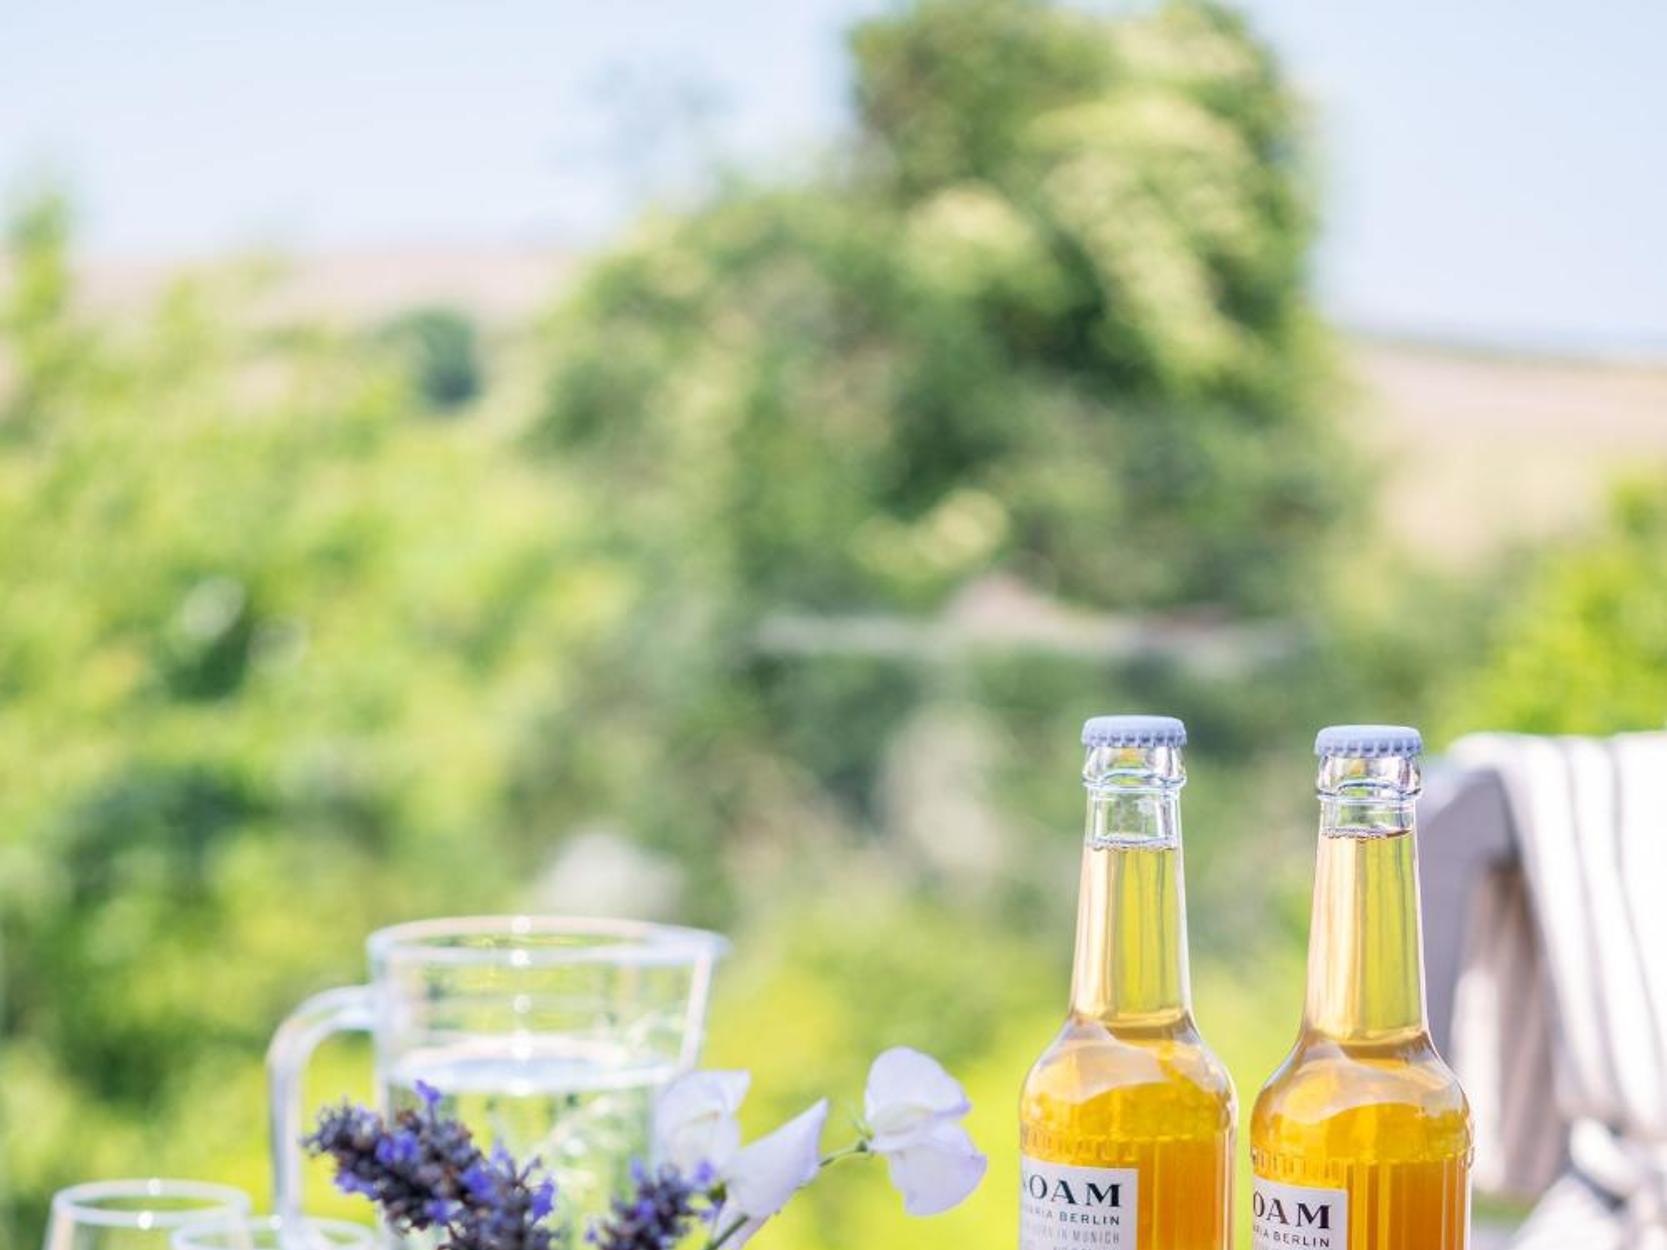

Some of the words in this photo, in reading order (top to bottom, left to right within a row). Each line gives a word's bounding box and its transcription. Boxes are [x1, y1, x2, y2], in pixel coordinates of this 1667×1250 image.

[1023, 1173, 1121, 1207] OAM
[1059, 1211, 1120, 1225] BERLIN
[1072, 1229, 1120, 1244] MUNICH
[1273, 1231, 1330, 1247] BERLIN
